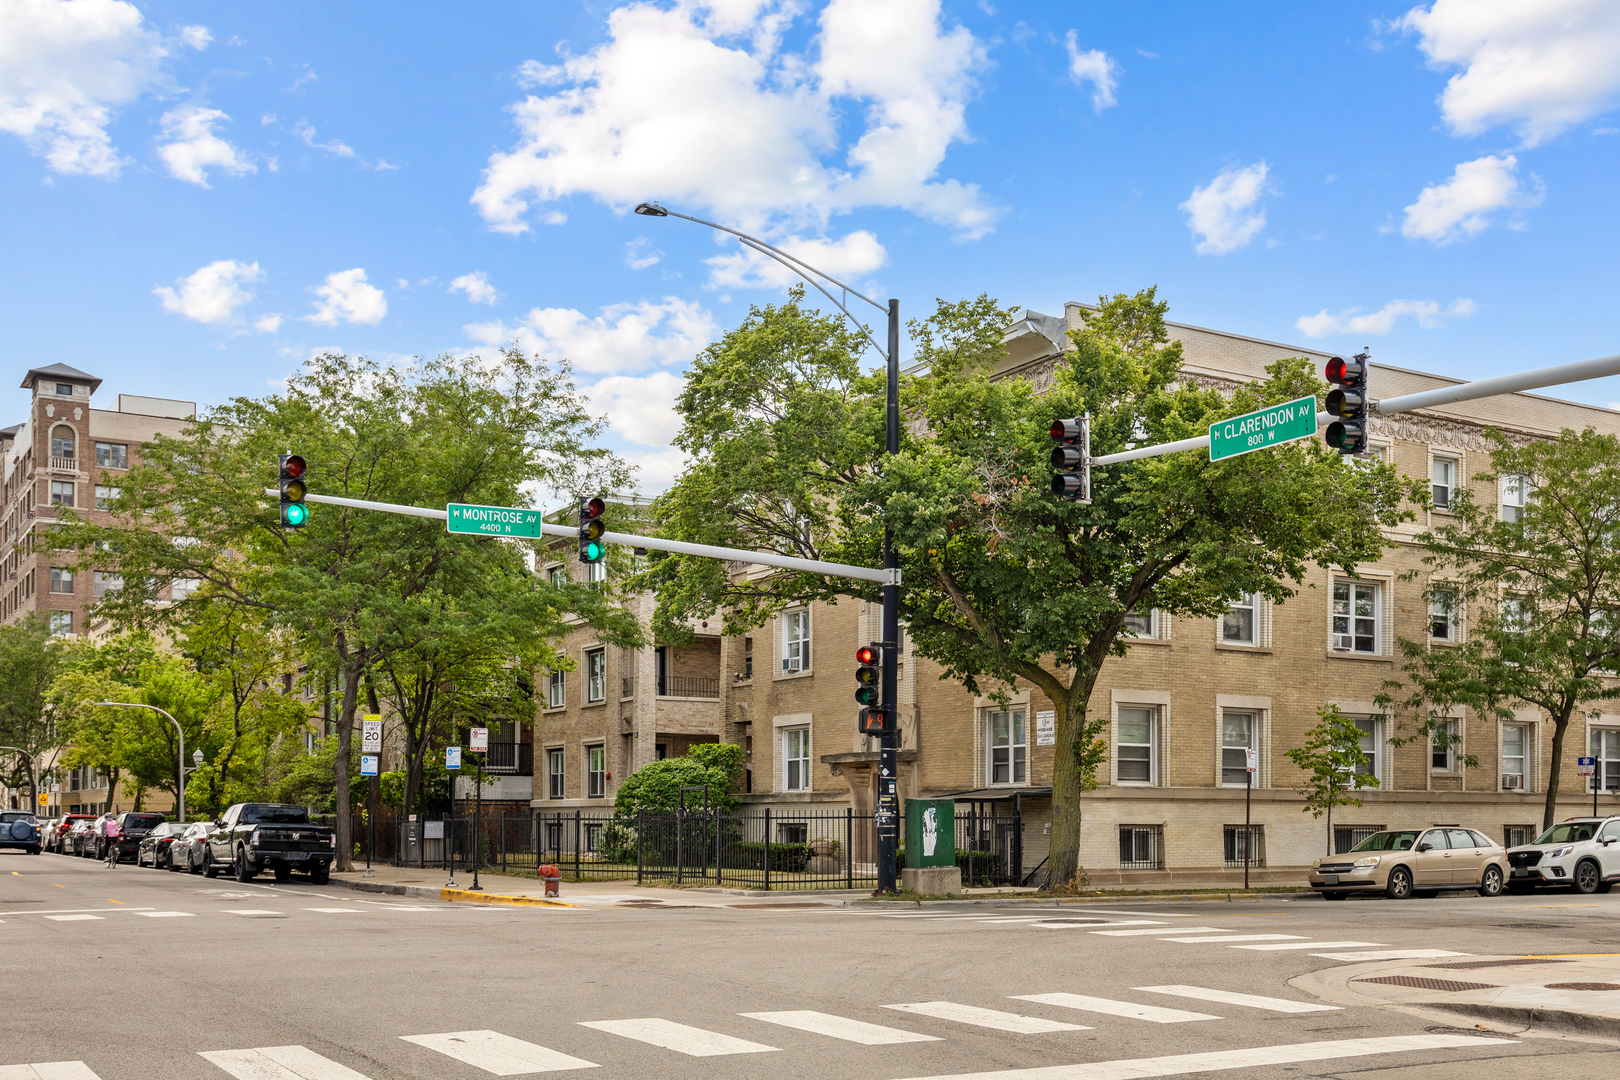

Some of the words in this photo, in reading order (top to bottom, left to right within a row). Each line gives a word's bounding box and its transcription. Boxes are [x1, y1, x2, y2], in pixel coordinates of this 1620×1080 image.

[1214, 430, 1220, 440] N
[1224, 407, 1294, 439] CLARENDON
[1298, 405, 1310, 417] AV
[1248, 433, 1264, 446] 800
[1267, 430, 1275, 441] W
[453, 509, 460, 517] W
[463, 508, 523, 524] MONTROSE
[526, 515, 537, 523] AV
[480, 523, 501, 532] 4400
[505, 525, 511, 533] N
[364, 731, 379, 741] 20
